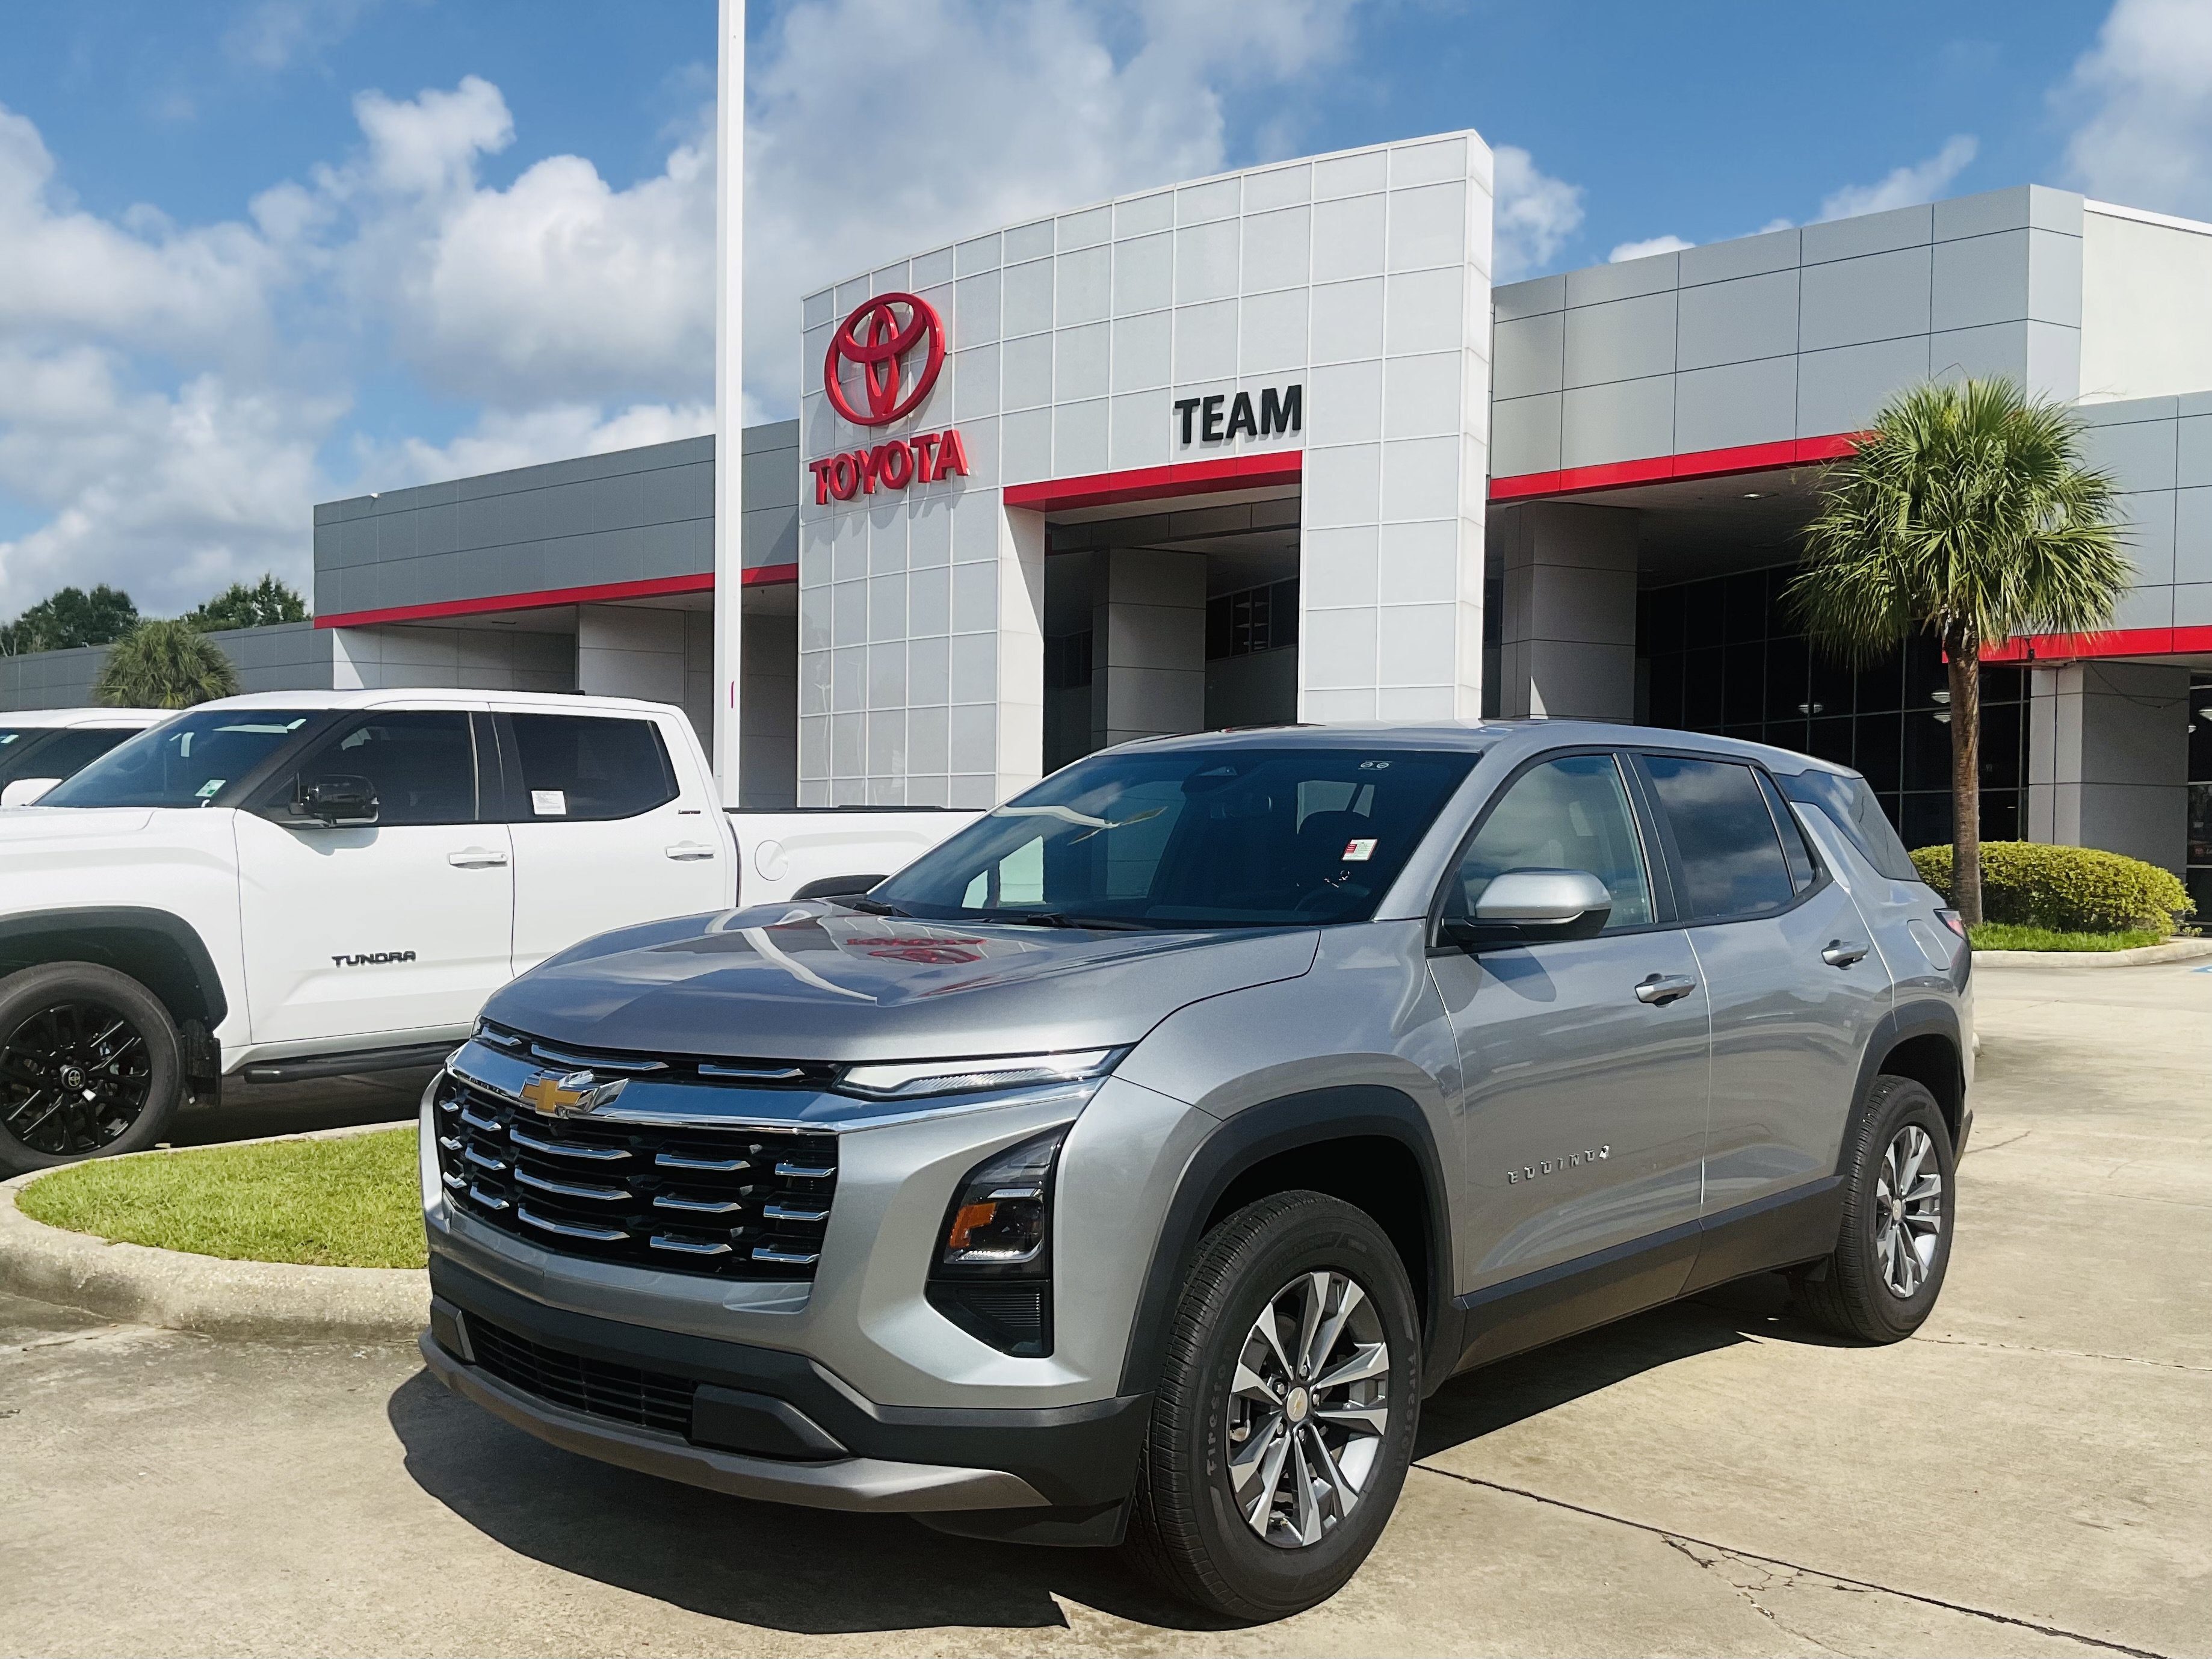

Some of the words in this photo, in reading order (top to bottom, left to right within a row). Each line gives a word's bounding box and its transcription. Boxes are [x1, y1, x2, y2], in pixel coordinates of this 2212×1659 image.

[1175, 384, 1302, 443] TEAM
[809, 429, 970, 505] TOYOTA
[331, 951, 416, 968] TUNDRA
[1206, 1345, 1231, 1476] Firesto
